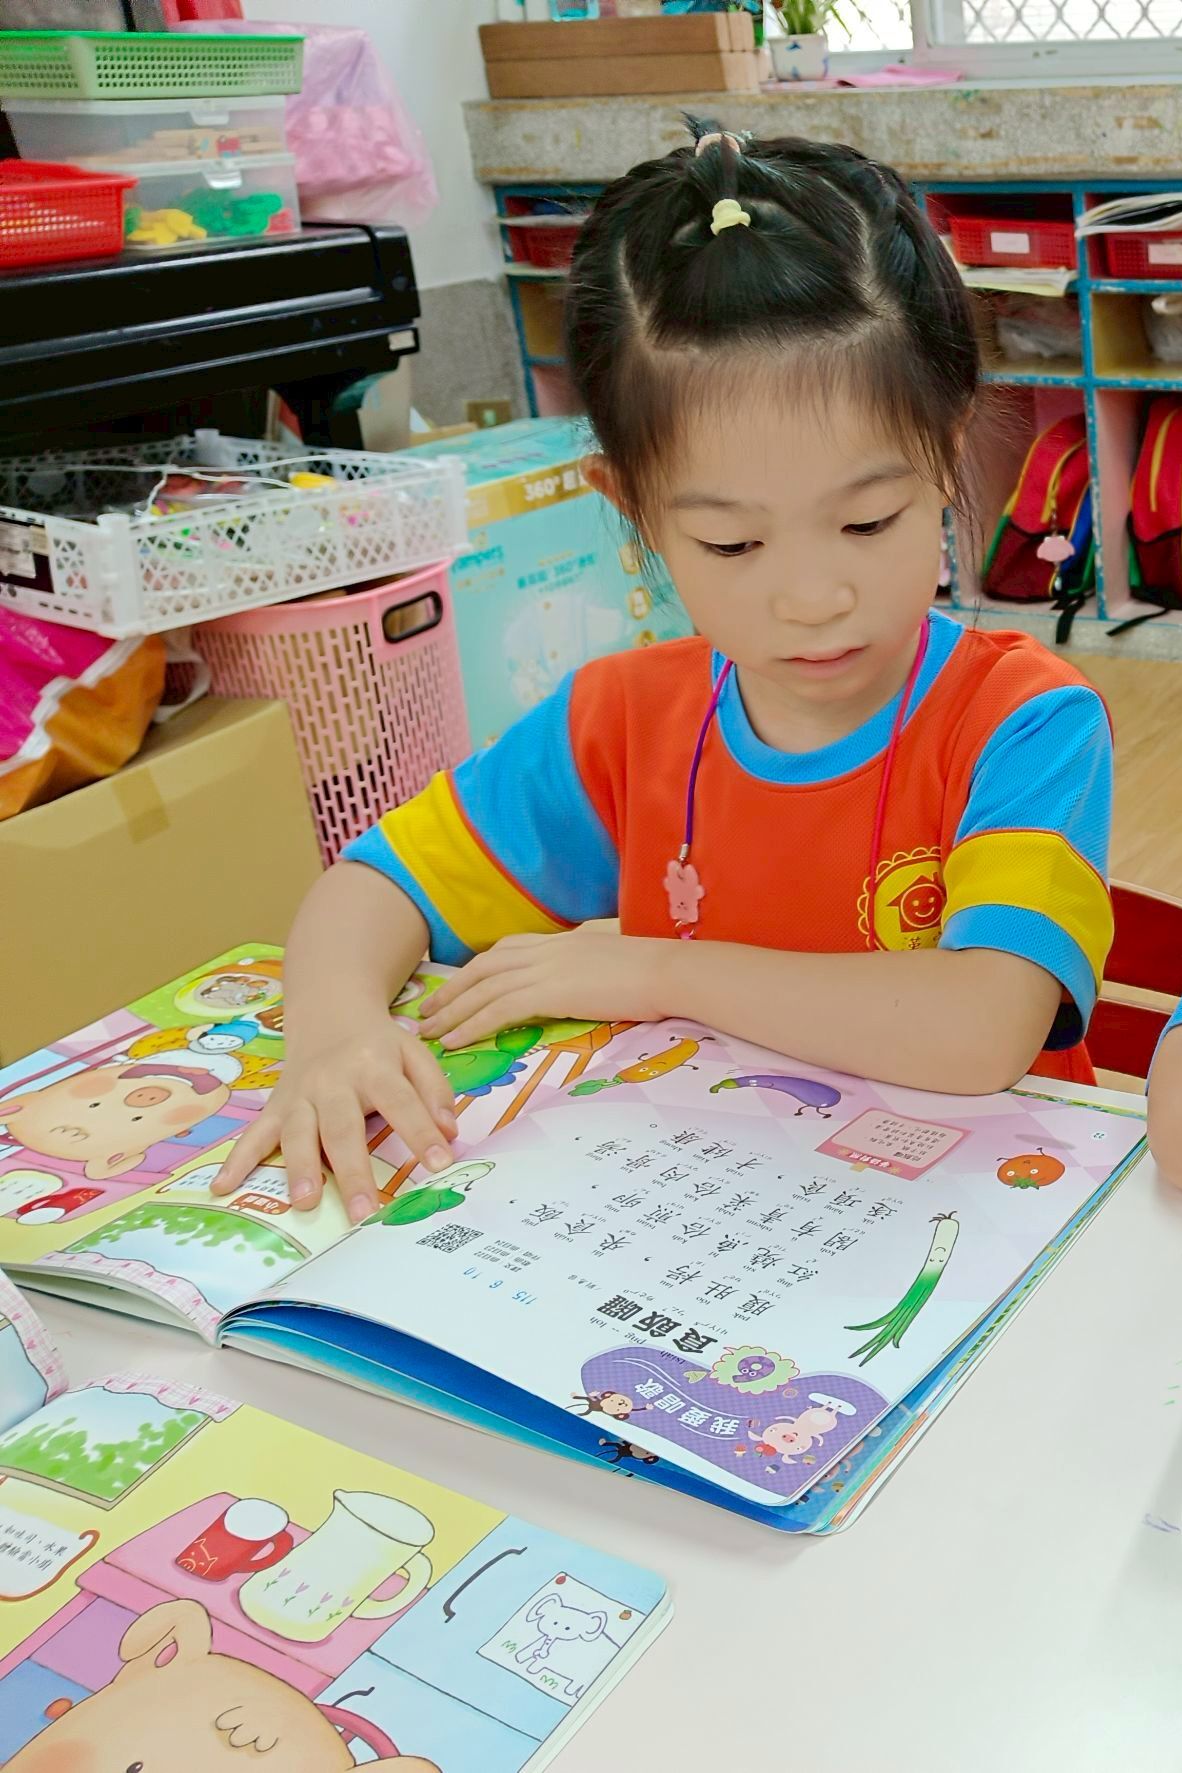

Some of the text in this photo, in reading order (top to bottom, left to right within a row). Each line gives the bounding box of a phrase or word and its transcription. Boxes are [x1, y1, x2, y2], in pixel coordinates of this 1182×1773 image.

[488, 1280, 504, 1289] 6
[596, 1294, 719, 1354] 食飯囉
[635, 1378, 740, 1435] 我愛唱歌
